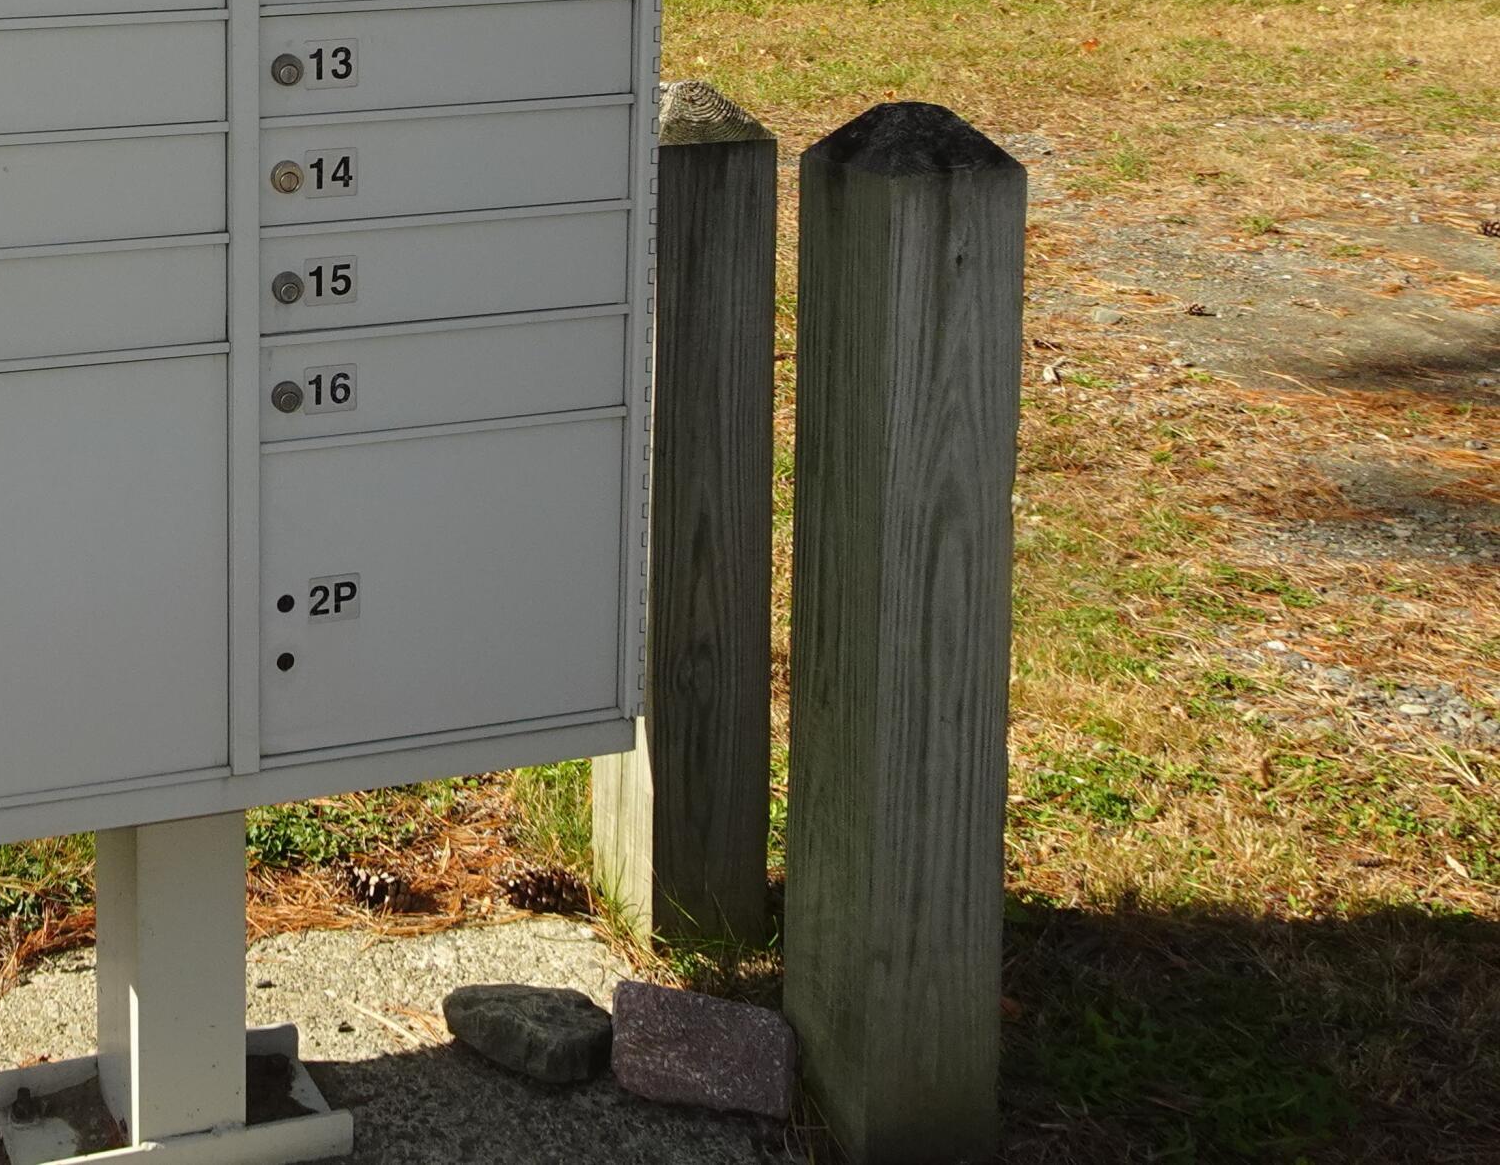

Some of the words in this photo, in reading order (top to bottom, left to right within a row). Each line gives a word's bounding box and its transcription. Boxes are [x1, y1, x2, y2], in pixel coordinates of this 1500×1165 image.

[309, 46, 353, 81] 13
[309, 156, 353, 190] 14
[308, 263, 352, 297] 15
[308, 372, 351, 406] 16
[309, 581, 357, 616] 2P
